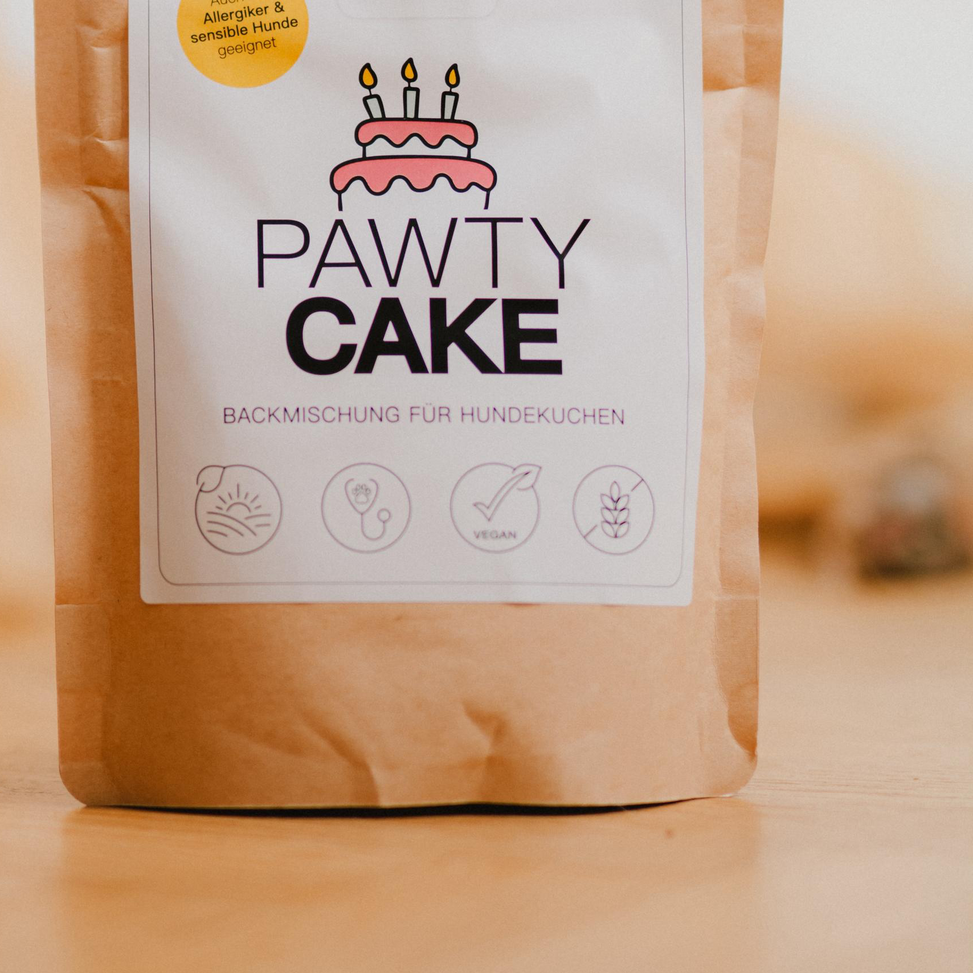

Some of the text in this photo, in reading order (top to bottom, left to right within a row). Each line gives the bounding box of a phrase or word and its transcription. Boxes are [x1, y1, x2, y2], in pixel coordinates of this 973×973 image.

[203, 1, 285, 25] Allergiker &
[190, 17, 299, 44] sensible Hunde
[217, 37, 277, 60] geeignet
[256, 217, 591, 289] PAWTY
[285, 297, 563, 376] CAKE
[223, 402, 625, 426] BACKMISCHUNG FÜR HUNDEKUCHEN
[473, 529, 516, 539] VEGAN
